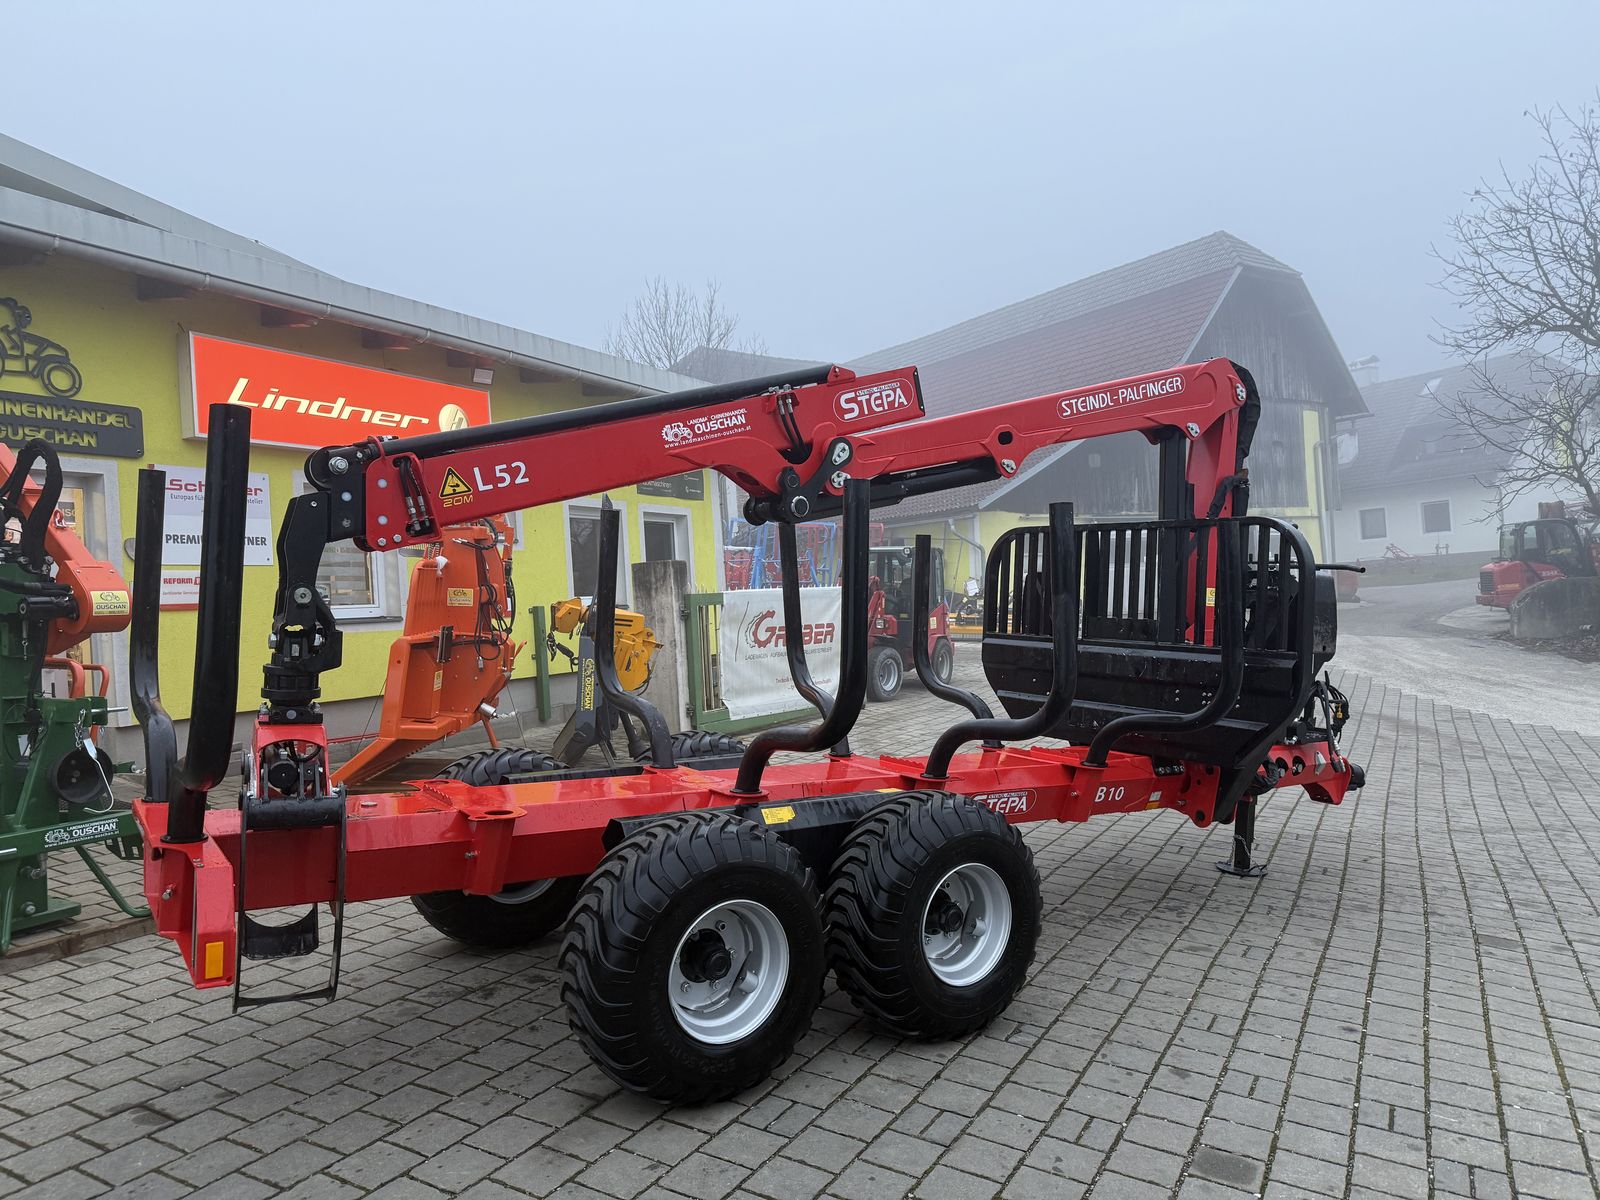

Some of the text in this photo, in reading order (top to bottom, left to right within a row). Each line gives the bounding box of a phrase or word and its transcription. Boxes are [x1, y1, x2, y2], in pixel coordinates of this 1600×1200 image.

[227, 377, 429, 429] Lindner
[840, 387, 908, 420] STEPA
[1061, 376, 1182, 417] STEINDL-PALFINGER
[694, 414, 746, 434] OUSCHAN
[663, 425, 752, 449] www.landmaschinen-ouschan.at
[443, 495, 474, 508] 20M
[163, 577, 193, 585] REFORM
[752, 609, 836, 649] GRBER
[72, 823, 117, 837] OUSCHAN
